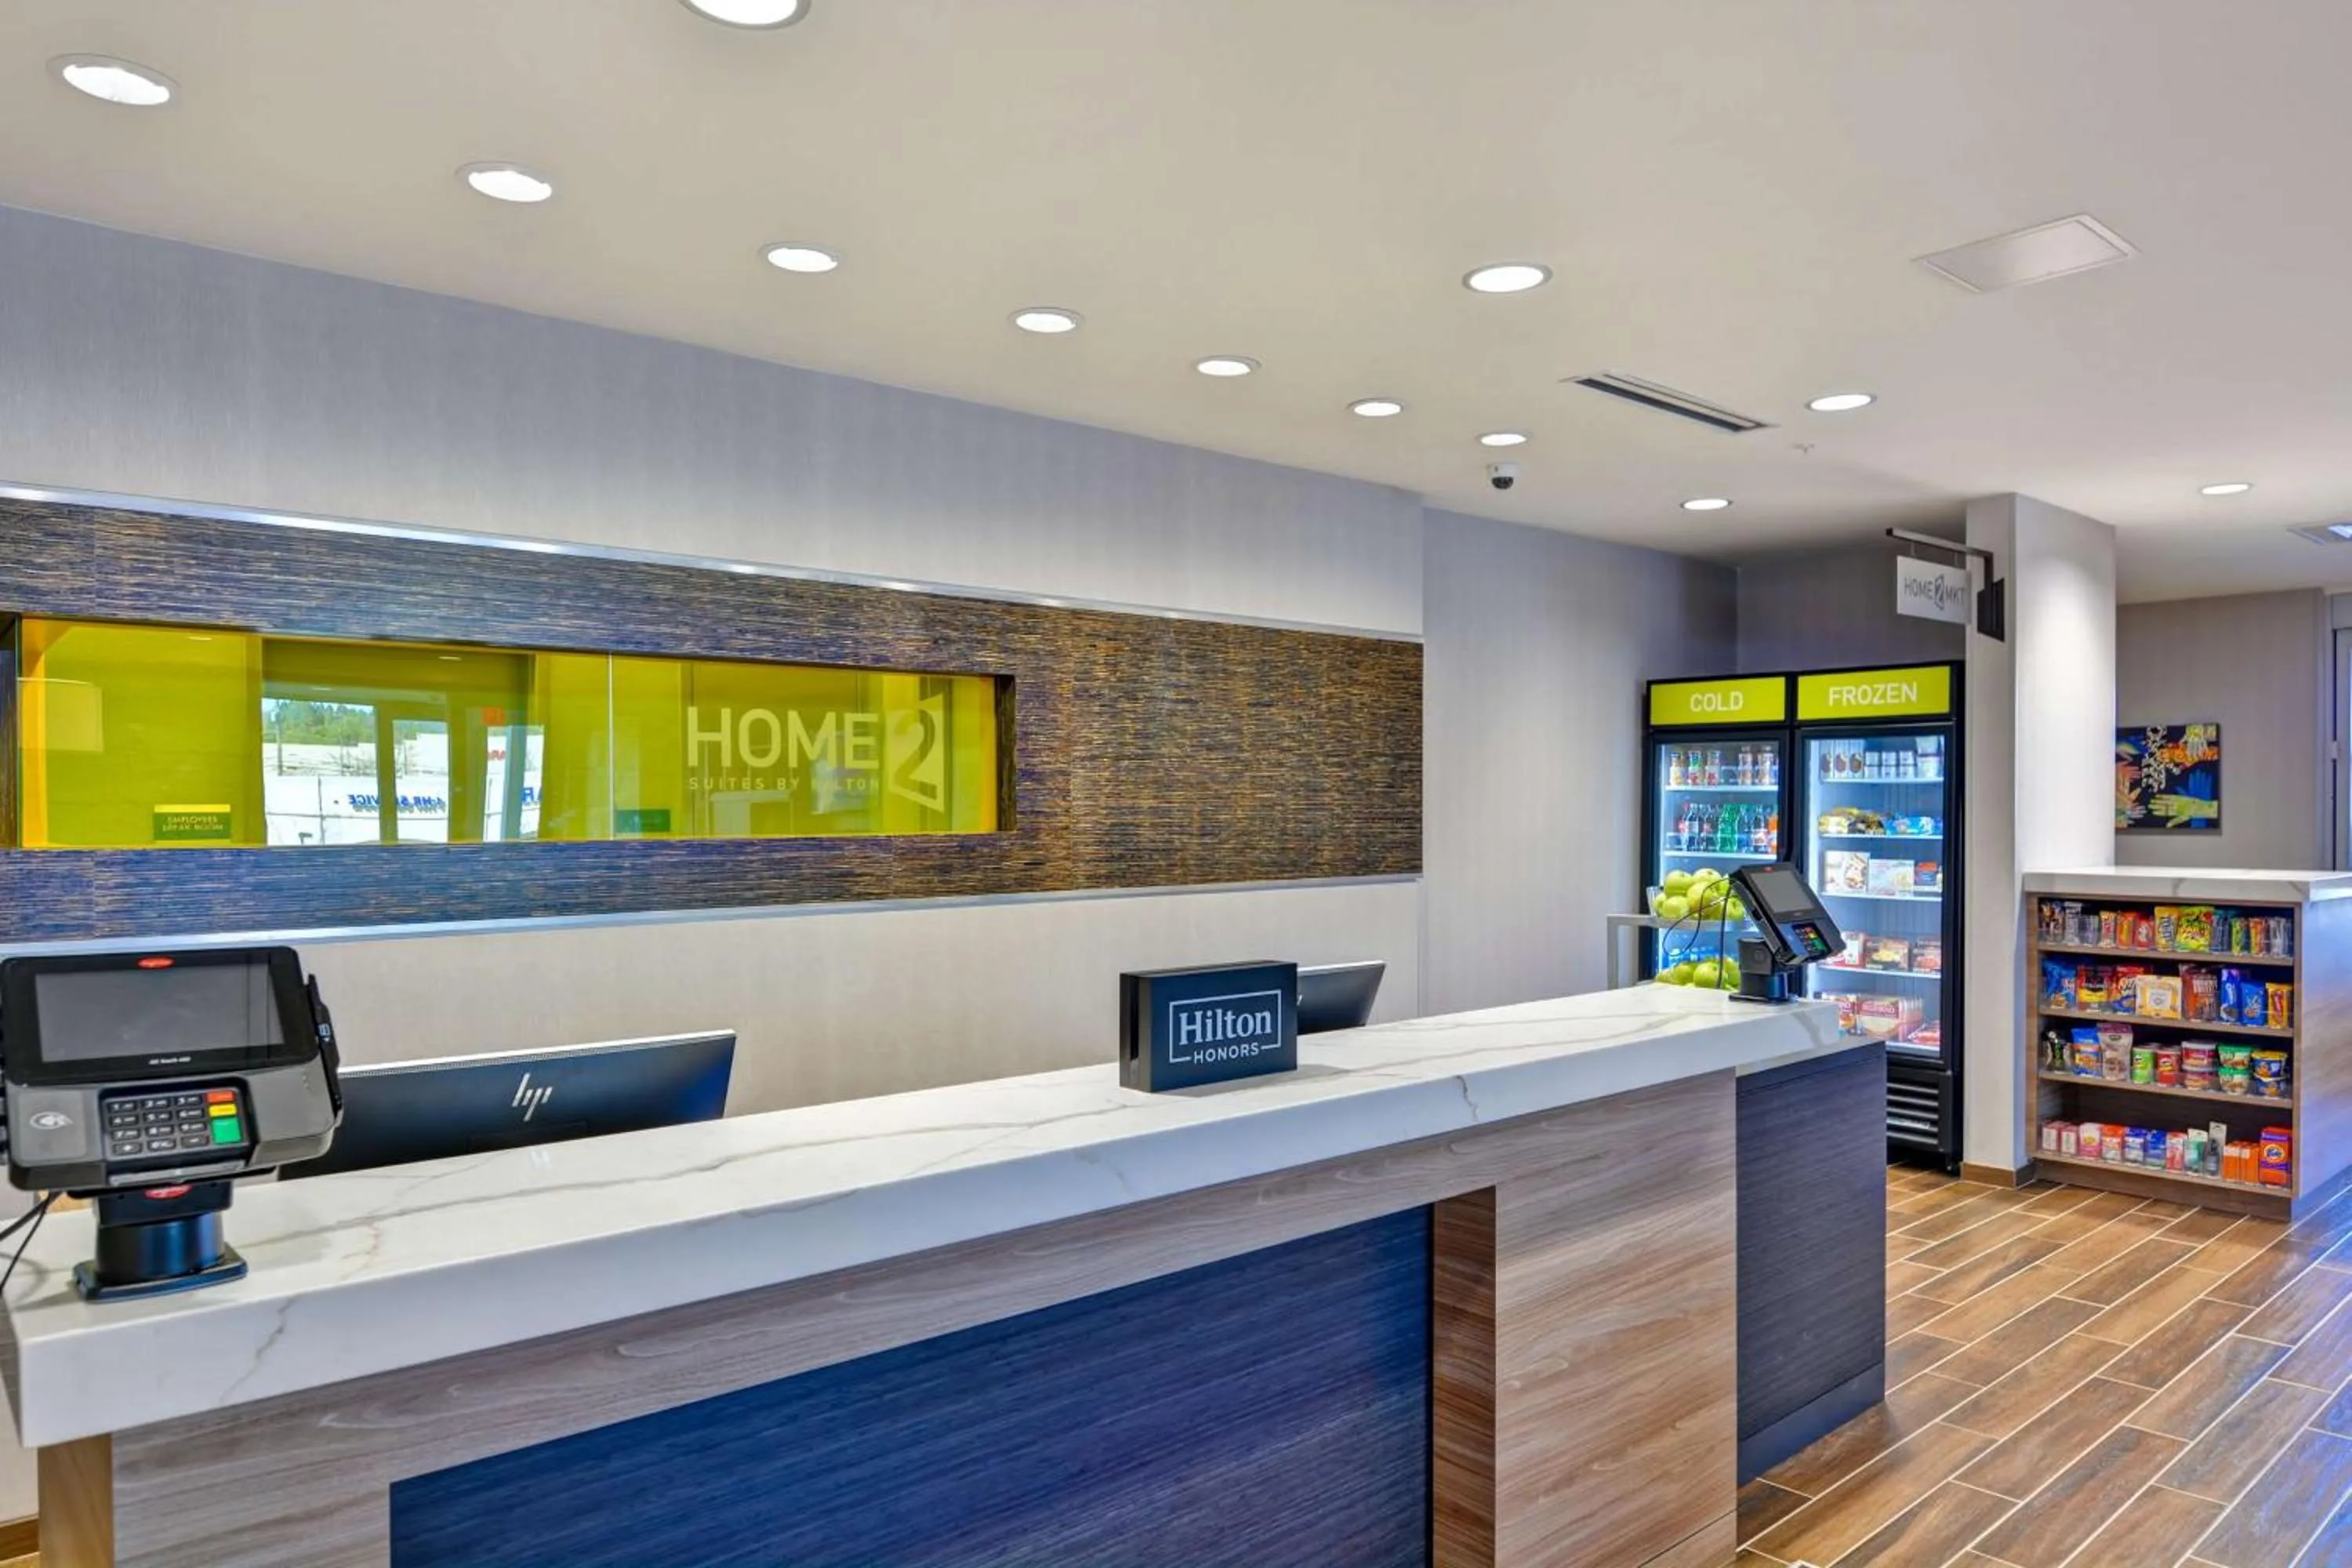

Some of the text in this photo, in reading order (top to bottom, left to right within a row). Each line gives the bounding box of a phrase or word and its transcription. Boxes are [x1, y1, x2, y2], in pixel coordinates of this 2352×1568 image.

[1904, 575, 1933, 601] HOME
[1690, 691, 1744, 712] COLD
[1828, 681, 1918, 706] FROZEN
[687, 706, 879, 769] HOME
[689, 776, 765, 790] SUITES
[777, 777, 800, 790] BY
[1178, 1008, 1272, 1046] Hilton
[1194, 1042, 1260, 1064] HONORS
[511, 1072, 554, 1123] hp
